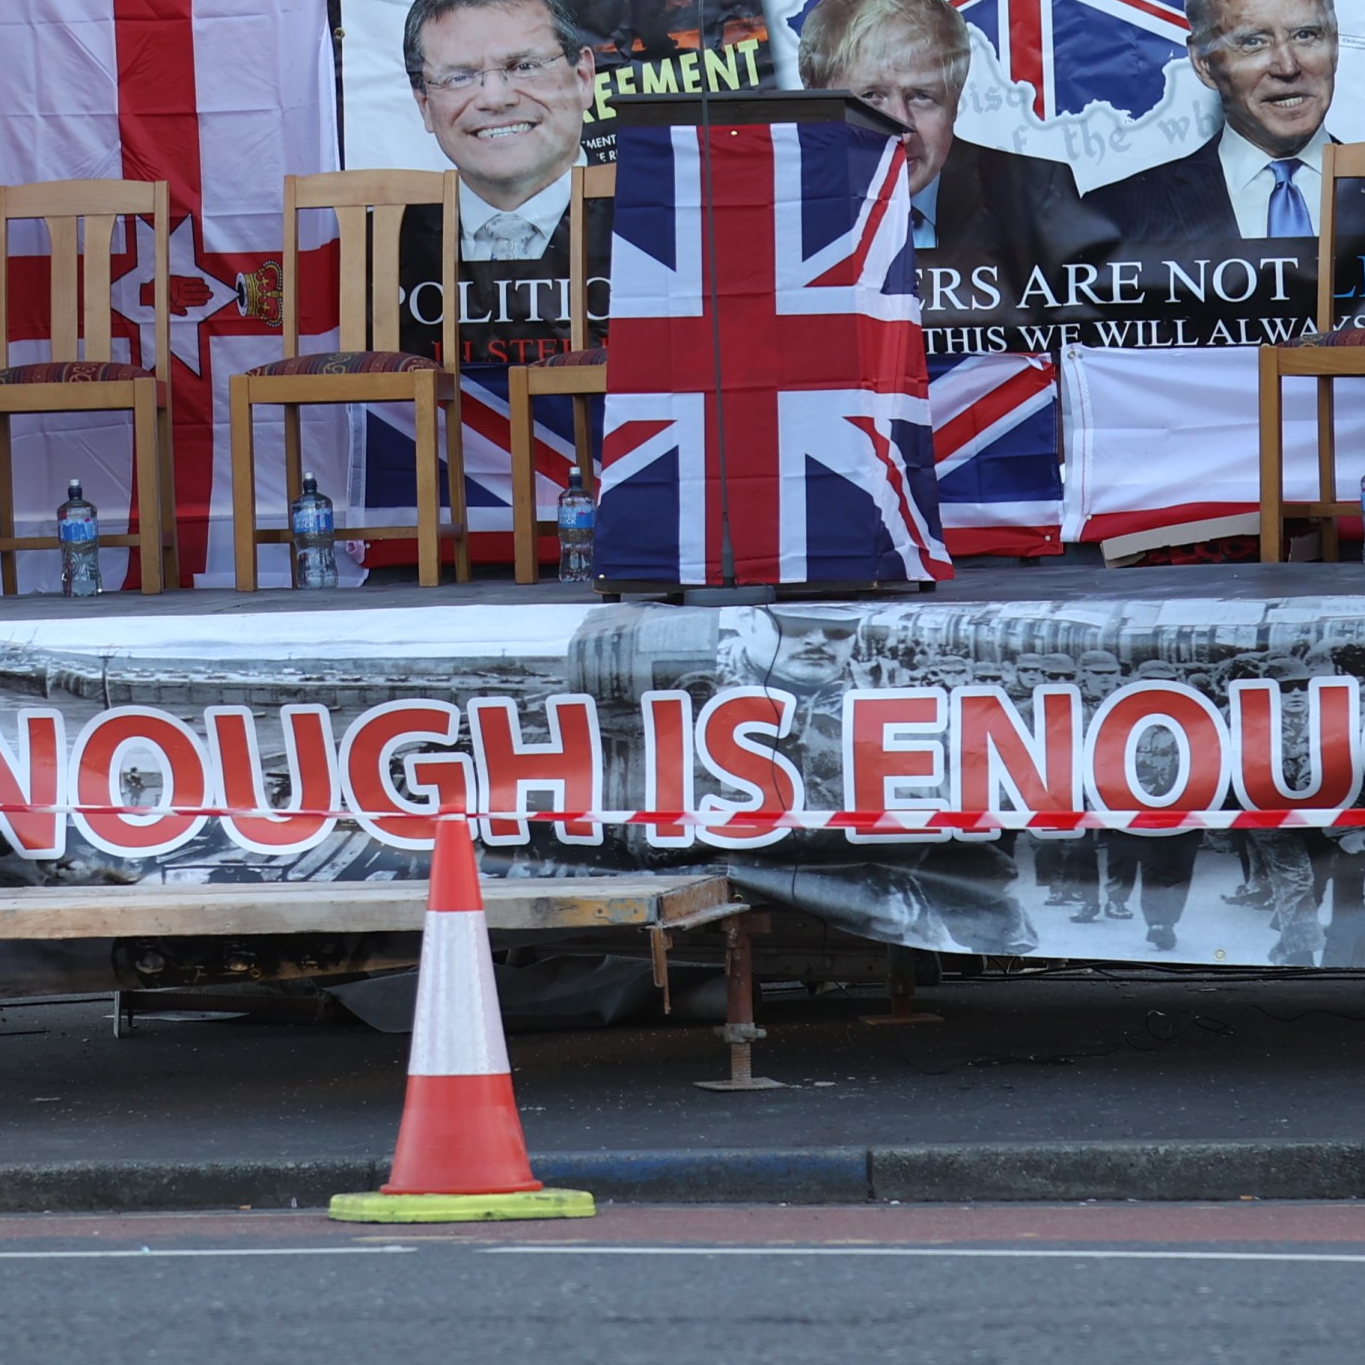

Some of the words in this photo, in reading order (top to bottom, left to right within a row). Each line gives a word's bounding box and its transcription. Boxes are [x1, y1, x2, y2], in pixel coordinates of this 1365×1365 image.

[581, 134, 617, 149] MENT
[916, 266, 1001, 312] RS
[1016, 261, 1147, 309] ARE
[1163, 257, 1299, 303] NOT
[922, 325, 1008, 355] THIS
[1017, 322, 1082, 352] WE
[1095, 319, 1200, 348] WILL
[641, 683, 804, 850] IS
